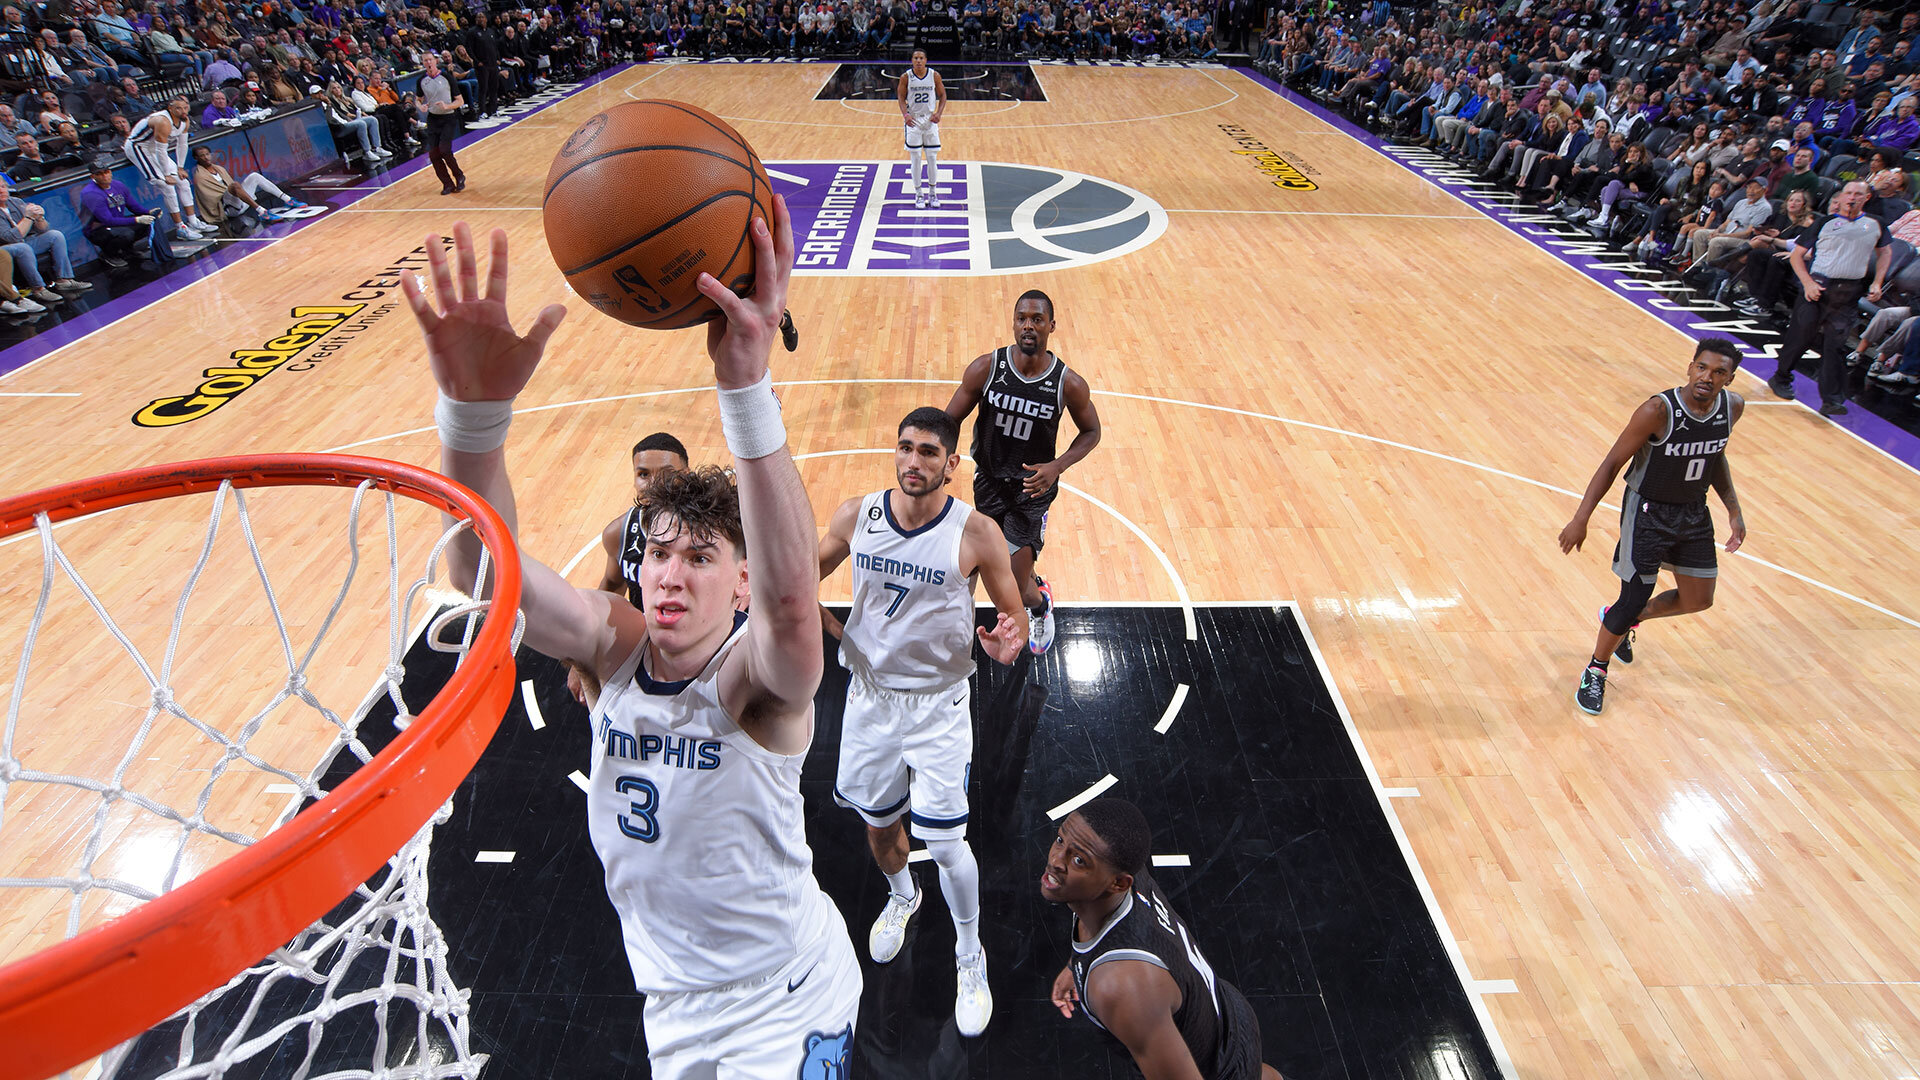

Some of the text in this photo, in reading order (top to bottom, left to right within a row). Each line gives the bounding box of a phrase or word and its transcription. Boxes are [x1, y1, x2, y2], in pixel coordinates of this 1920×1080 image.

[929, 25, 953, 33] dialpad
[914, 93, 929, 104] 22
[1380, 145, 1497, 186] PROUD
[796, 165, 868, 265] SACRAMENTO
[286, 303, 398, 372] Credit Union
[999, 360, 1006, 369] 6
[988, 390, 1055, 419] KINGS
[1675, 409, 1682, 417] 6
[995, 412, 1033, 441] 40
[1664, 437, 1728, 456] KINGS
[1684, 458, 1705, 481] 0
[631, 522, 639, 533] 6
[871, 508, 880, 519] 6
[856, 552, 946, 586] MEMPHIS
[883, 582, 910, 618] 7
[599, 712, 721, 770] MMPHIS
[615, 775, 660, 843] 3
